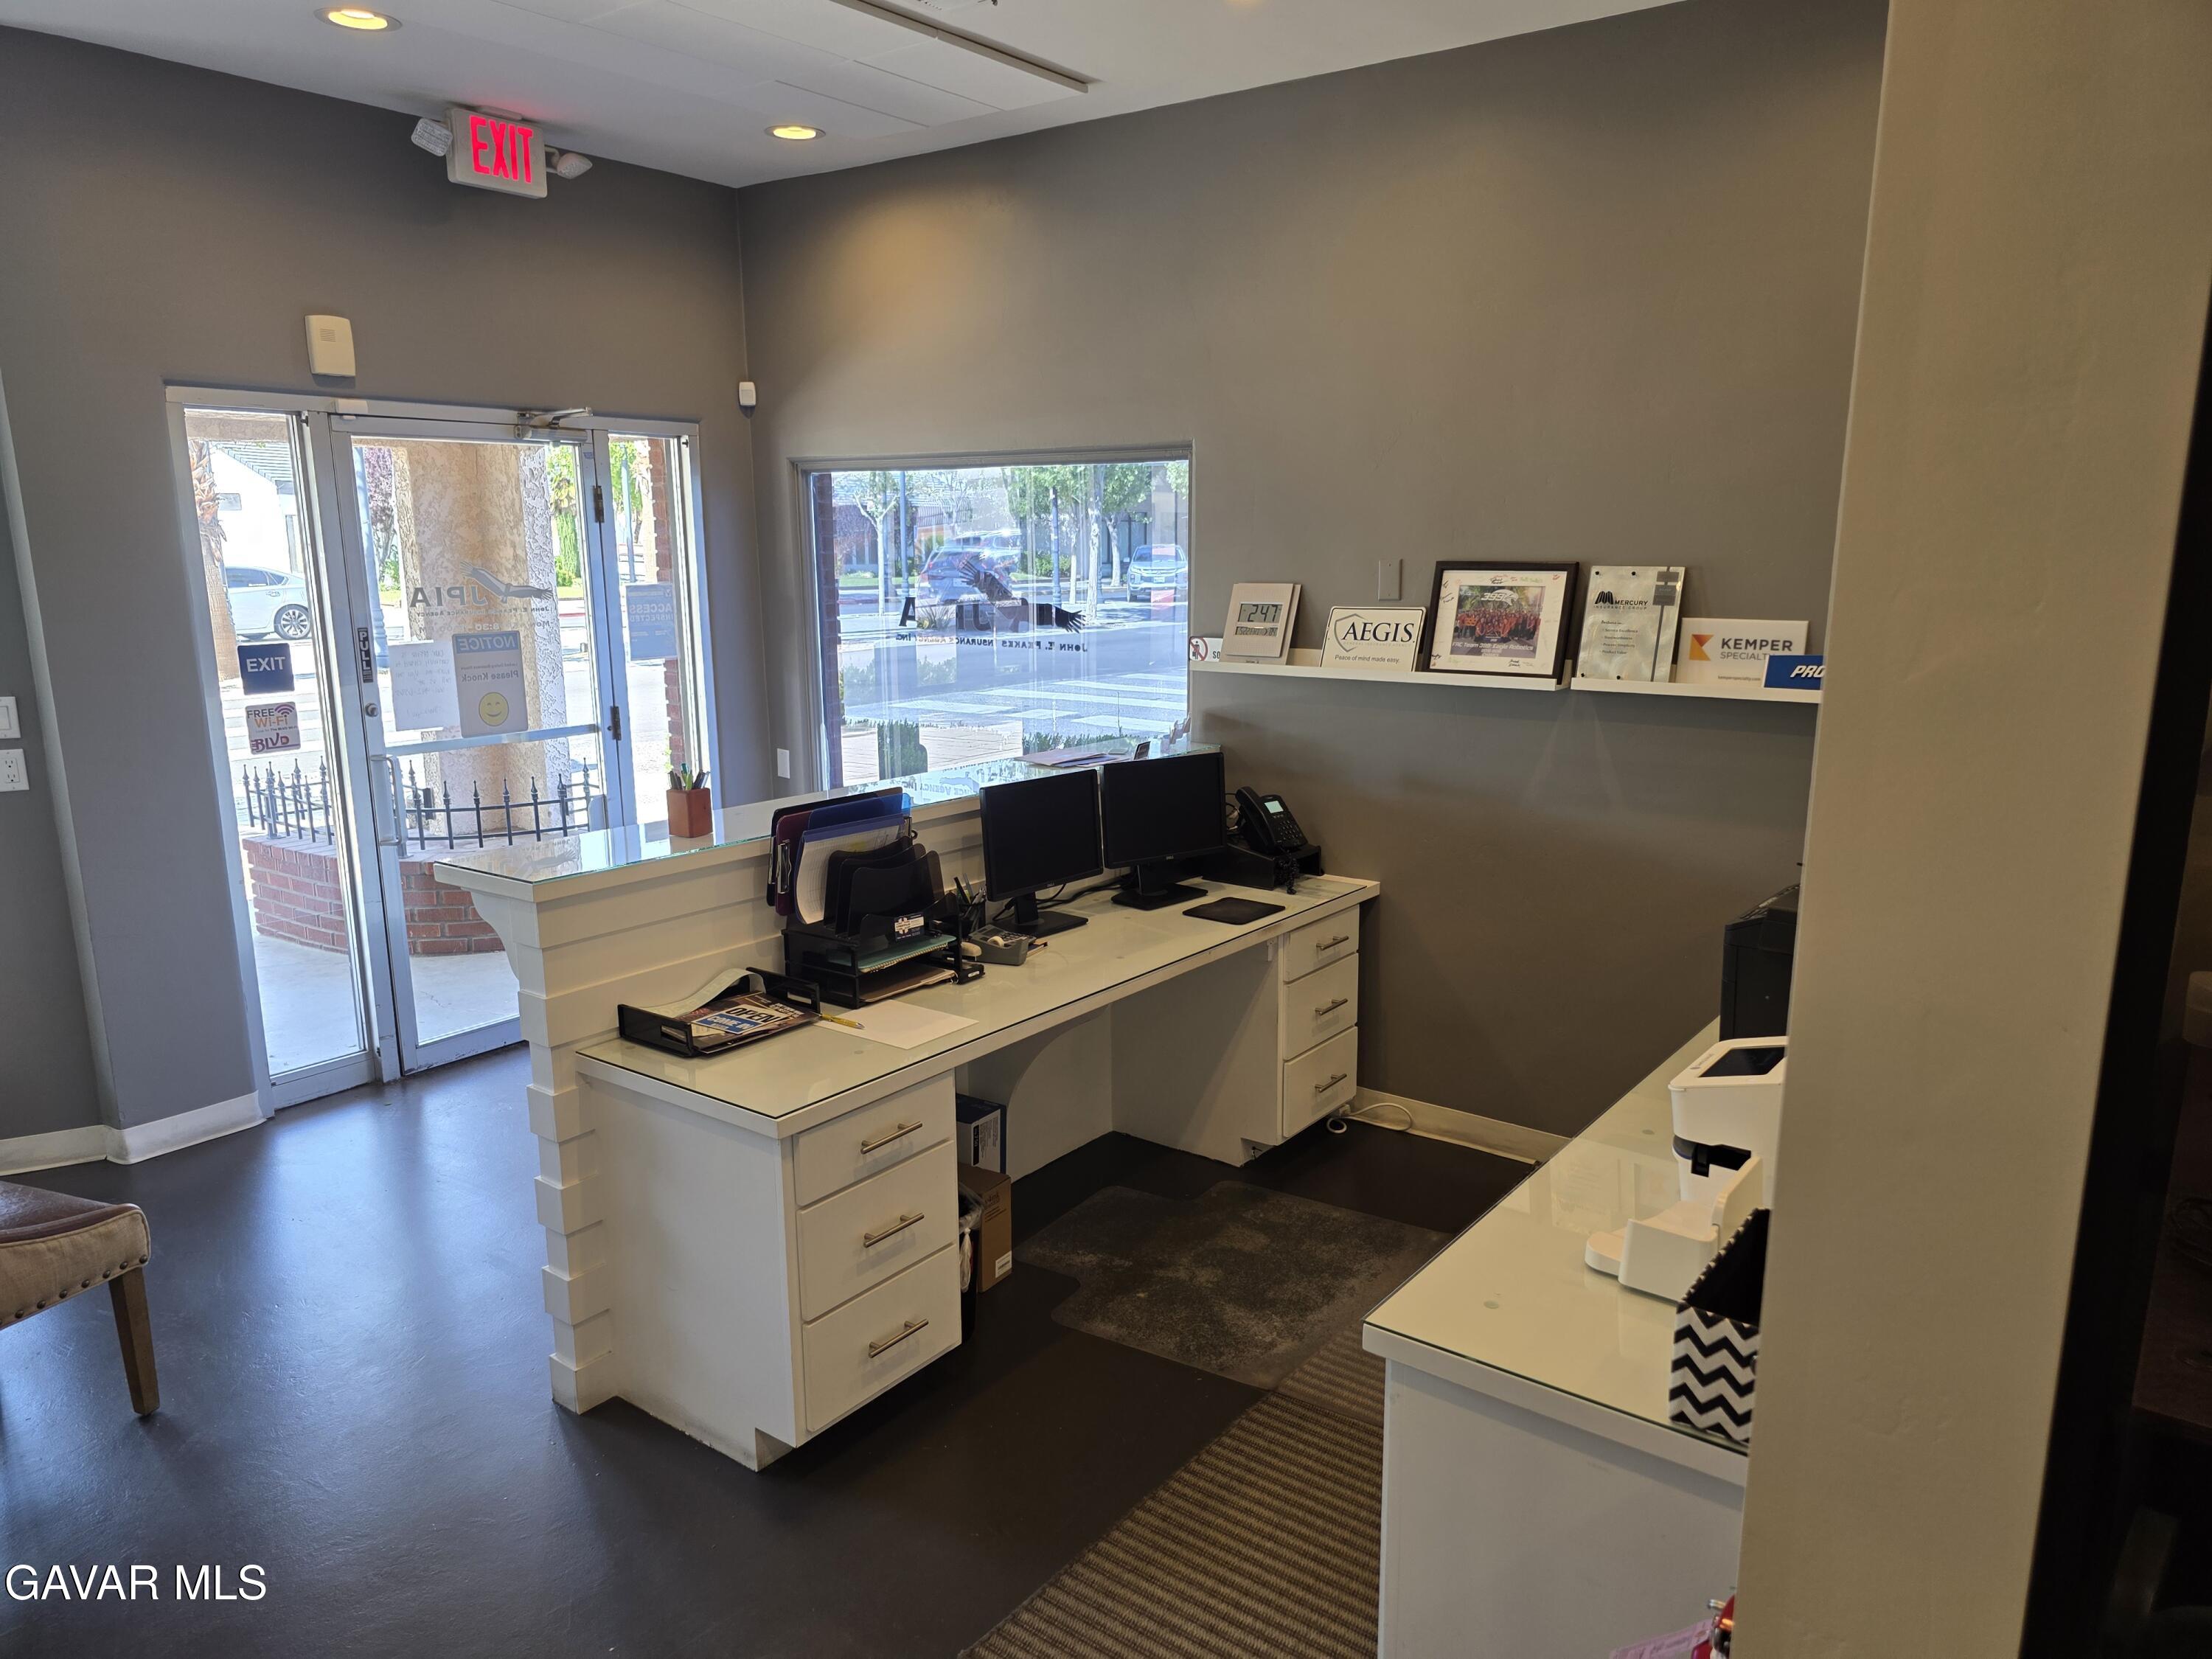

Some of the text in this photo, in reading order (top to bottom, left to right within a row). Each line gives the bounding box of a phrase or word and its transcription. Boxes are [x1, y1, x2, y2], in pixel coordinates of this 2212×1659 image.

[469, 114, 534, 184] EXIT
[359, 631, 371, 670] PULL
[1721, 638, 1793, 652] KEMPER
[1719, 652, 1770, 661] SPECIALT
[246, 656, 286, 672] EXIT
[247, 707, 275, 719] FREE
[255, 715, 288, 728] Wi-Fi
[725, 1007, 780, 1023] OPEN
[706, 1016, 741, 1027] COME
[739, 1022, 755, 1030] IN
